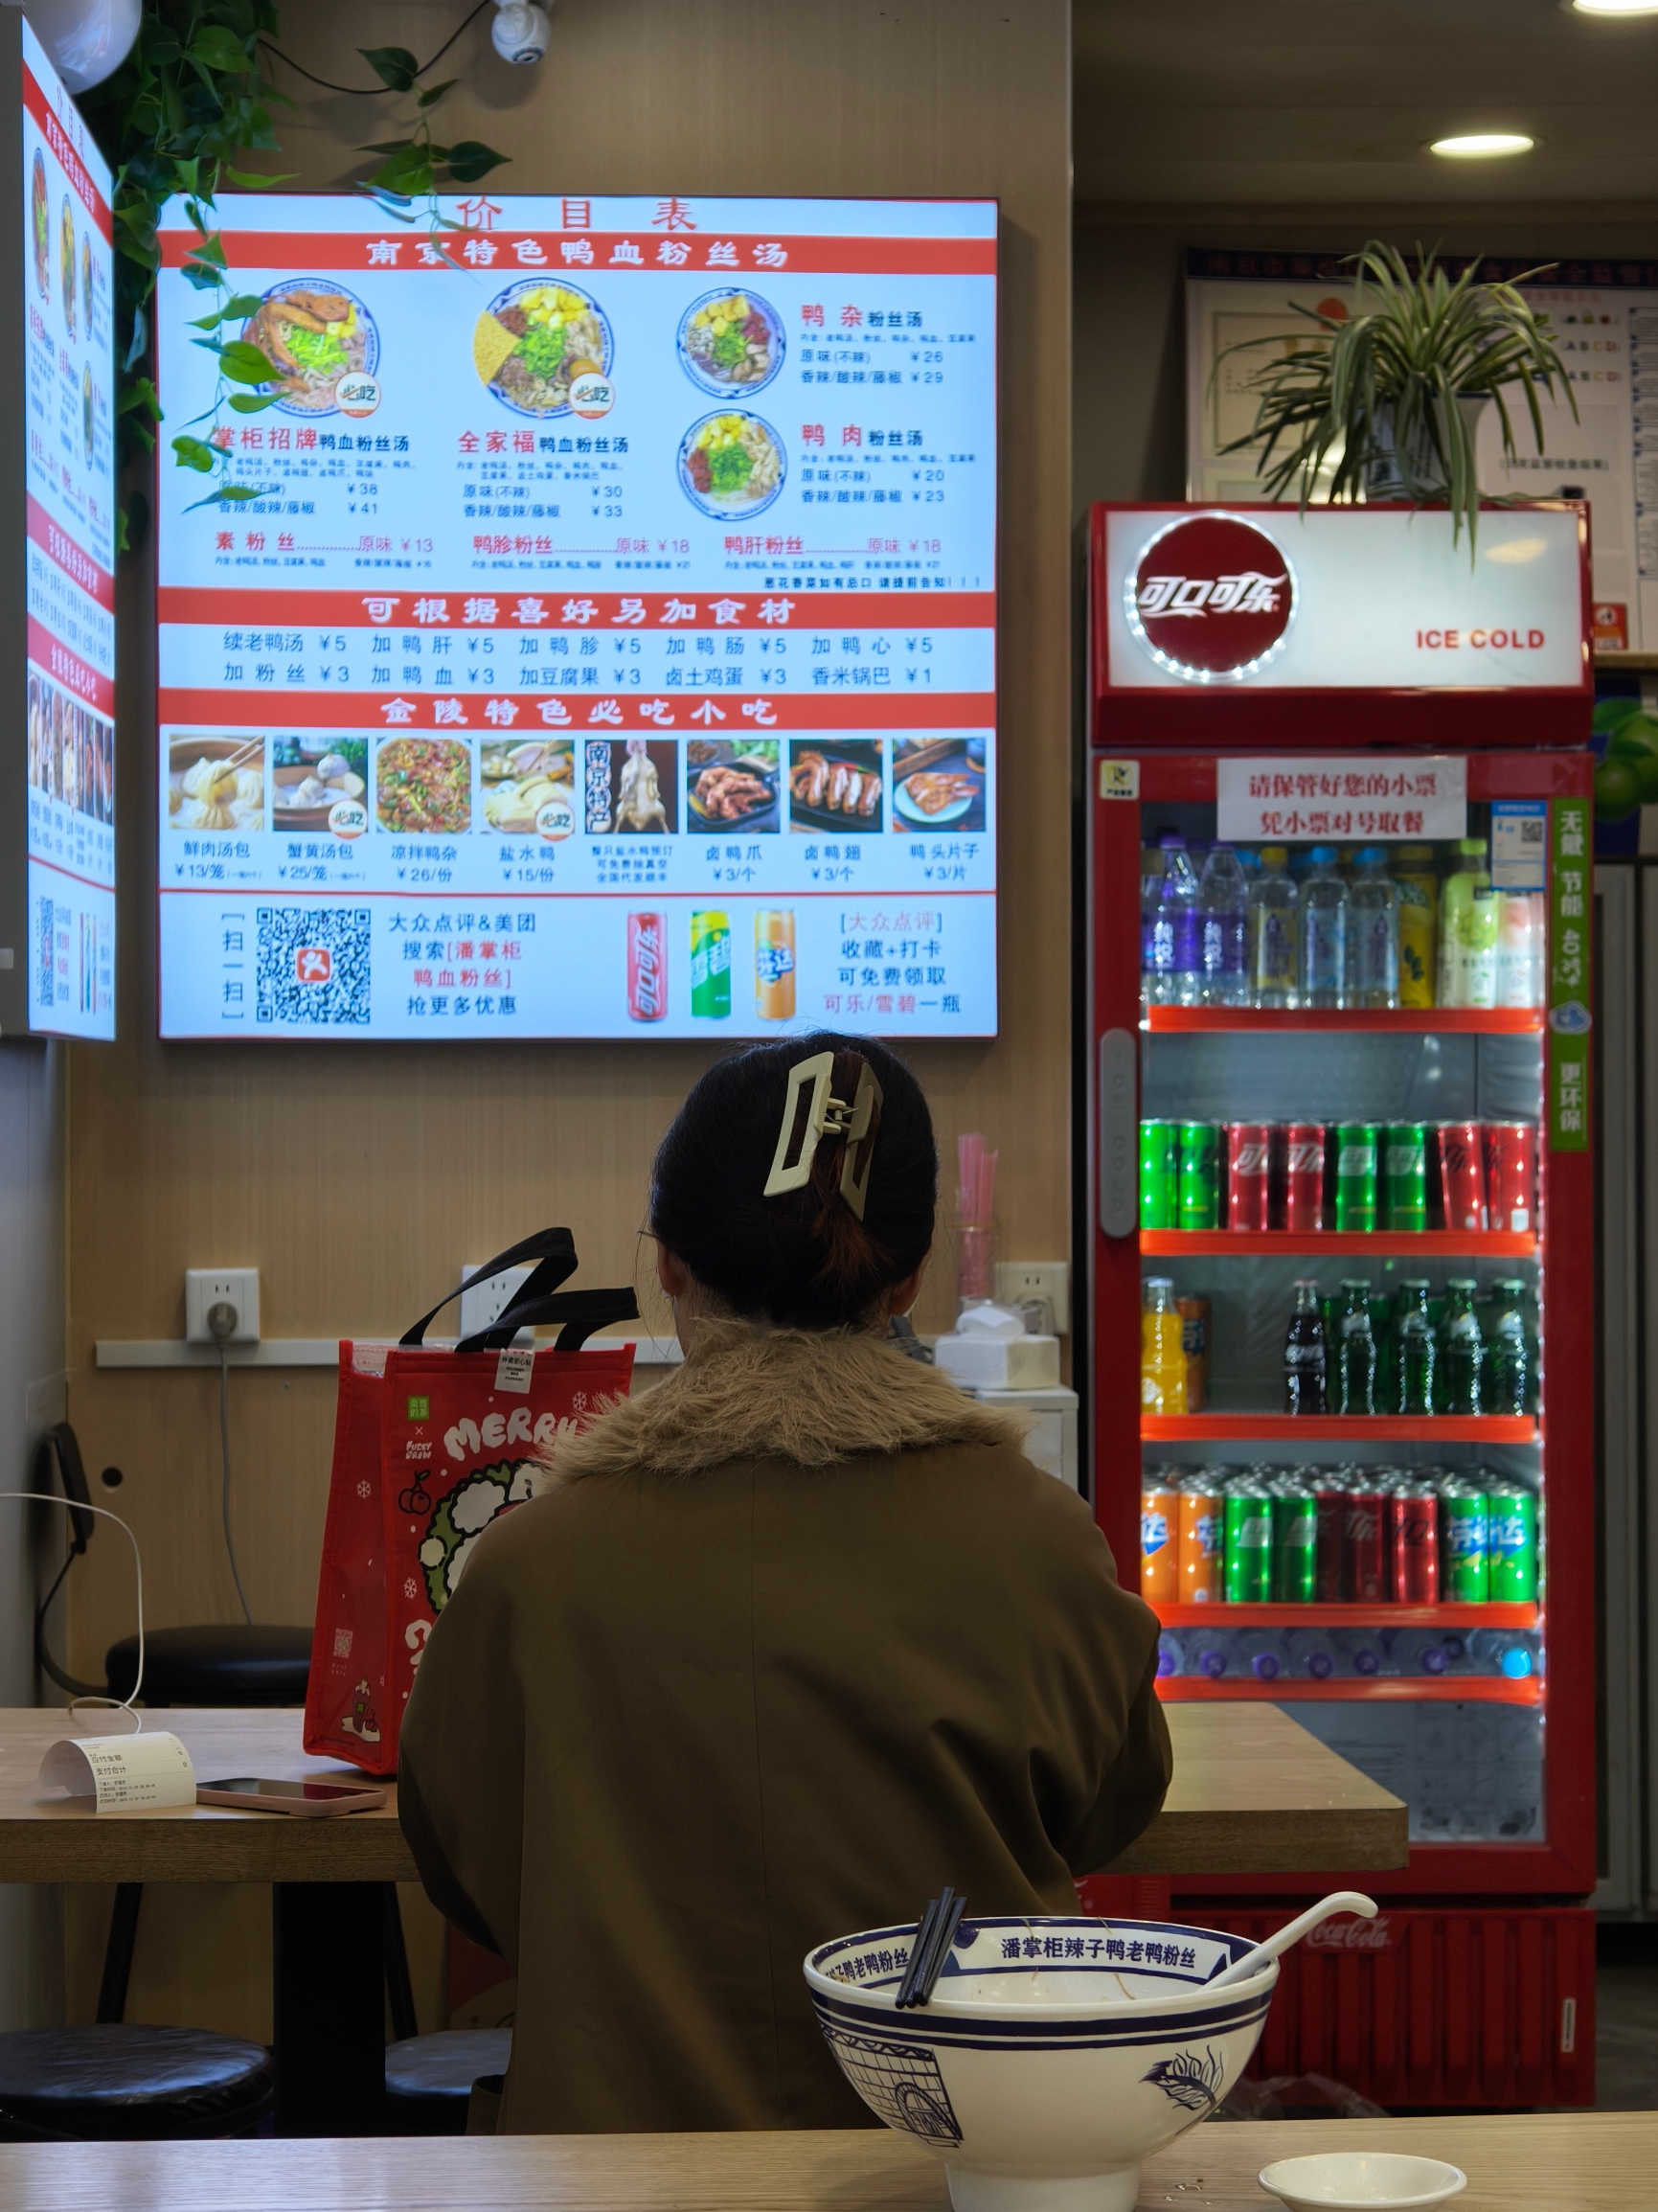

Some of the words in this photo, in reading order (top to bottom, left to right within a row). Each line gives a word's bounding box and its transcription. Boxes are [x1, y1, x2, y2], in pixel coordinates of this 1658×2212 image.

[456, 196, 696, 232] 价目表
[366, 239, 788, 267] 南京特色鸭血粉丝汤
[592, 486, 623, 497] ¥30
[348, 503, 377, 513] ¥41
[592, 506, 623, 516] ¥33
[1136, 571, 1289, 618] 可口可乐
[361, 597, 795, 625] 可根据喜好另加食材
[319, 635, 346, 652] ¥5
[372, 634, 452, 655] 加鸭肝
[467, 637, 494, 654] ¥5
[614, 638, 641, 654] ¥5
[666, 636, 744, 655] 加鸭肠
[761, 638, 786, 654] ¥5
[811, 636, 892, 655] 加鸭心
[905, 638, 933, 654] ¥5
[1416, 629, 1459, 650] ICE
[1469, 629, 1546, 650] COLD
[223, 662, 306, 683] 加粉丝
[319, 667, 350, 683] ¥3
[372, 666, 452, 685] 加鸭血
[467, 668, 494, 684] ¥3
[614, 669, 641, 685] ¥3
[666, 667, 743, 686] 卤土鸡蛋
[761, 669, 787, 685] ¥3
[812, 667, 892, 686] 香米锅巴
[905, 669, 931, 685] ¥1
[380, 697, 778, 725] 金陵特色必吃小吃
[1249, 774, 1438, 799] 请保管好您的小票
[1261, 811, 1425, 835] 凭小票对号取餐
[184, 840, 250, 858] 鲜肉汤包
[287, 842, 353, 860] 蟹黄汤包
[391, 844, 457, 862] 凉拌鸭杂
[499, 845, 555, 862] 盐水鸭
[910, 843, 980, 859] 鸭头片子
[389, 912, 535, 933] 大众点评&美团
[841, 939, 942, 959] 收藏+打卡
[837, 967, 946, 986] 可免费领取
[407, 995, 517, 1015] 抢更多优惠
[824, 993, 962, 1015] 可乐/雪碧一瓶
[1001, 1936, 1197, 1970] 潘掌柜辣子鸭老鸭粉丝
